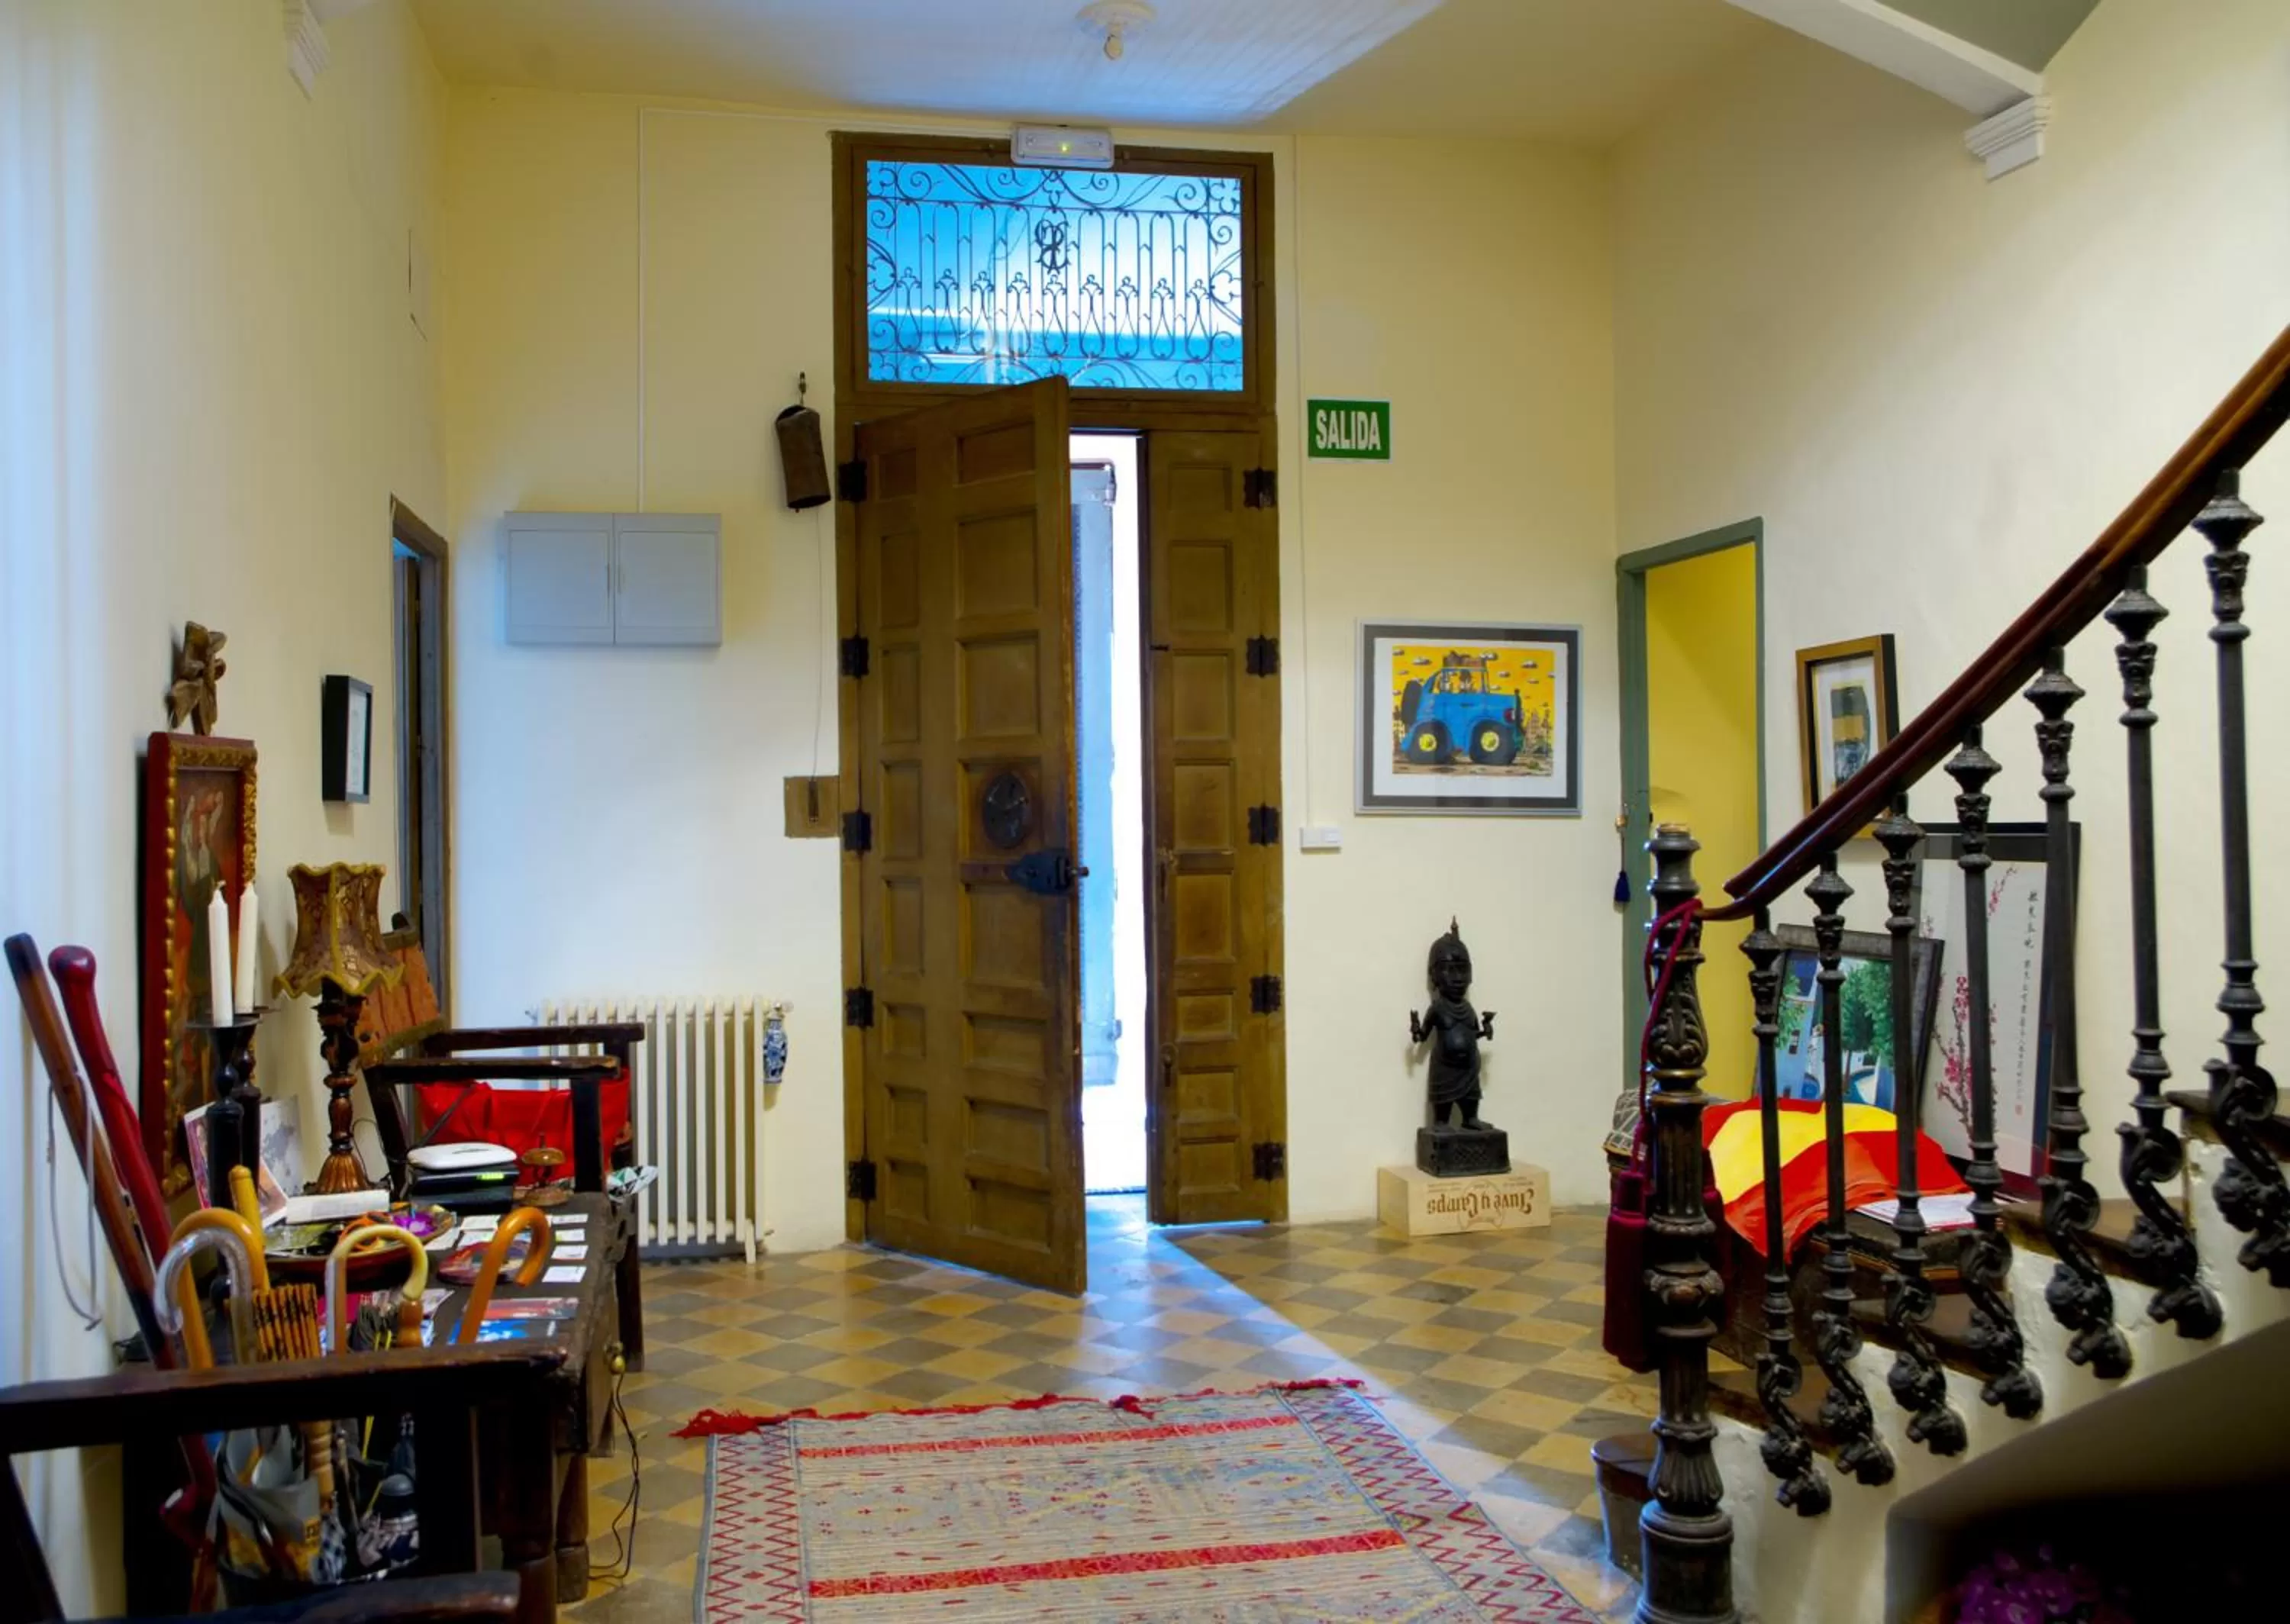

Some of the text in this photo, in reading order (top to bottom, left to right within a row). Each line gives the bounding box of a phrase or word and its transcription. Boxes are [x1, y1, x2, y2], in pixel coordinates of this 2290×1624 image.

[1316, 409, 1381, 450] SALIDA
[1427, 1193, 1478, 1218] Camps
[1482, 1190, 1491, 1209] y
